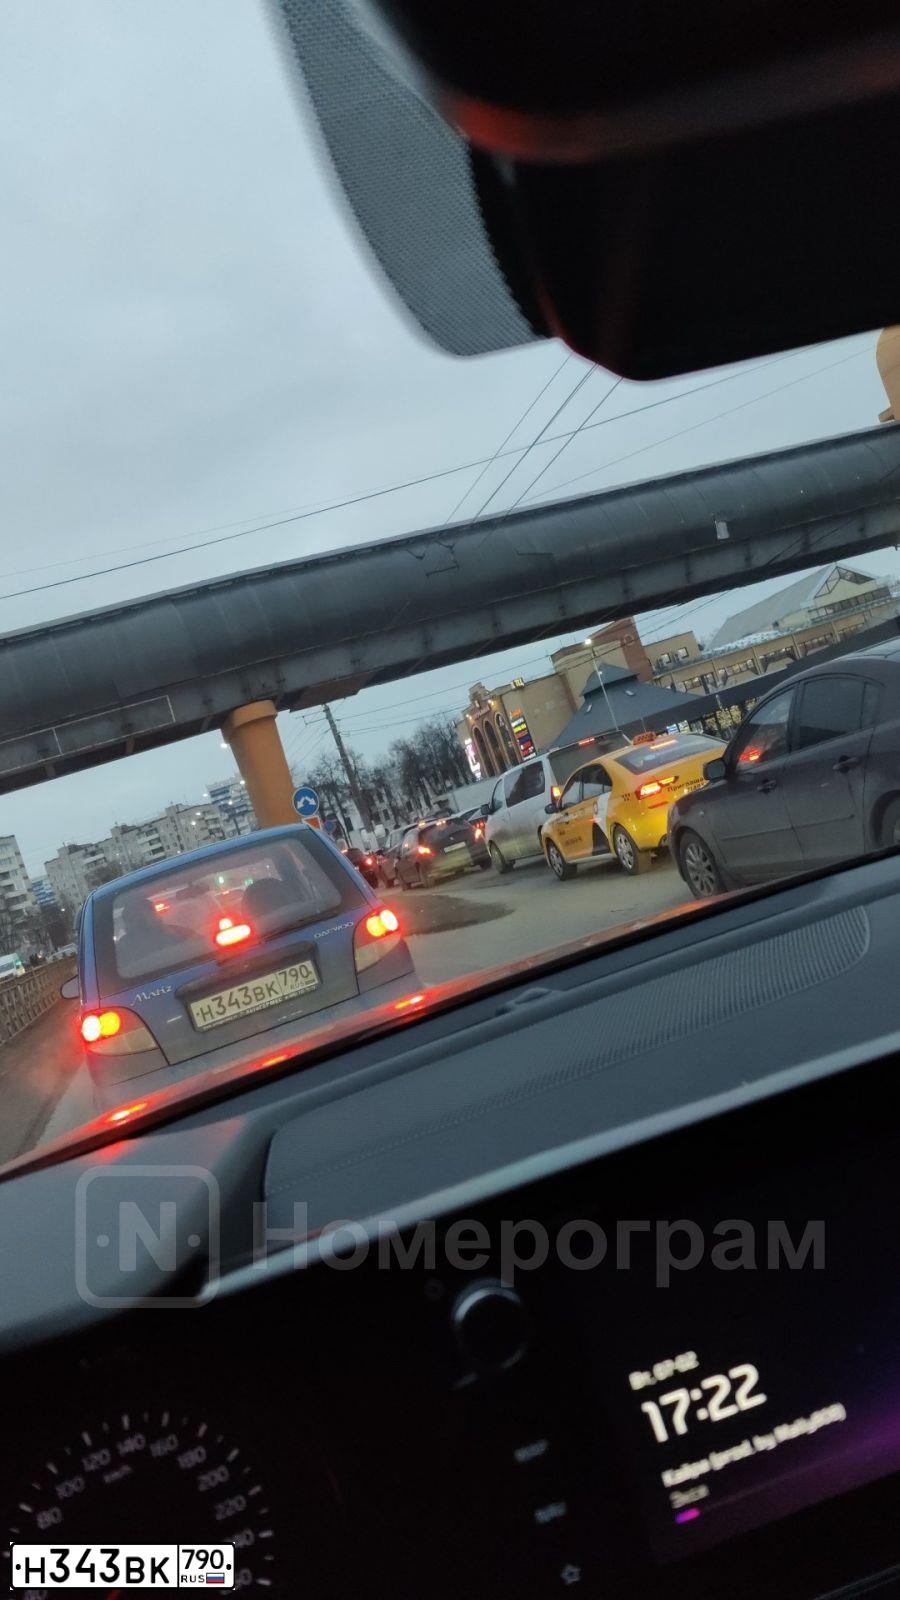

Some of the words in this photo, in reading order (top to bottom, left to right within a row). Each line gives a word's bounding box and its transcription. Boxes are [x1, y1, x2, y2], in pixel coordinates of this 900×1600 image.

[313, 921, 354, 938] DAEWOO
[201, 980, 280, 1022] Н343ВК
[279, 963, 311, 987] 790
[641, 1363, 768, 1443] 17:22
